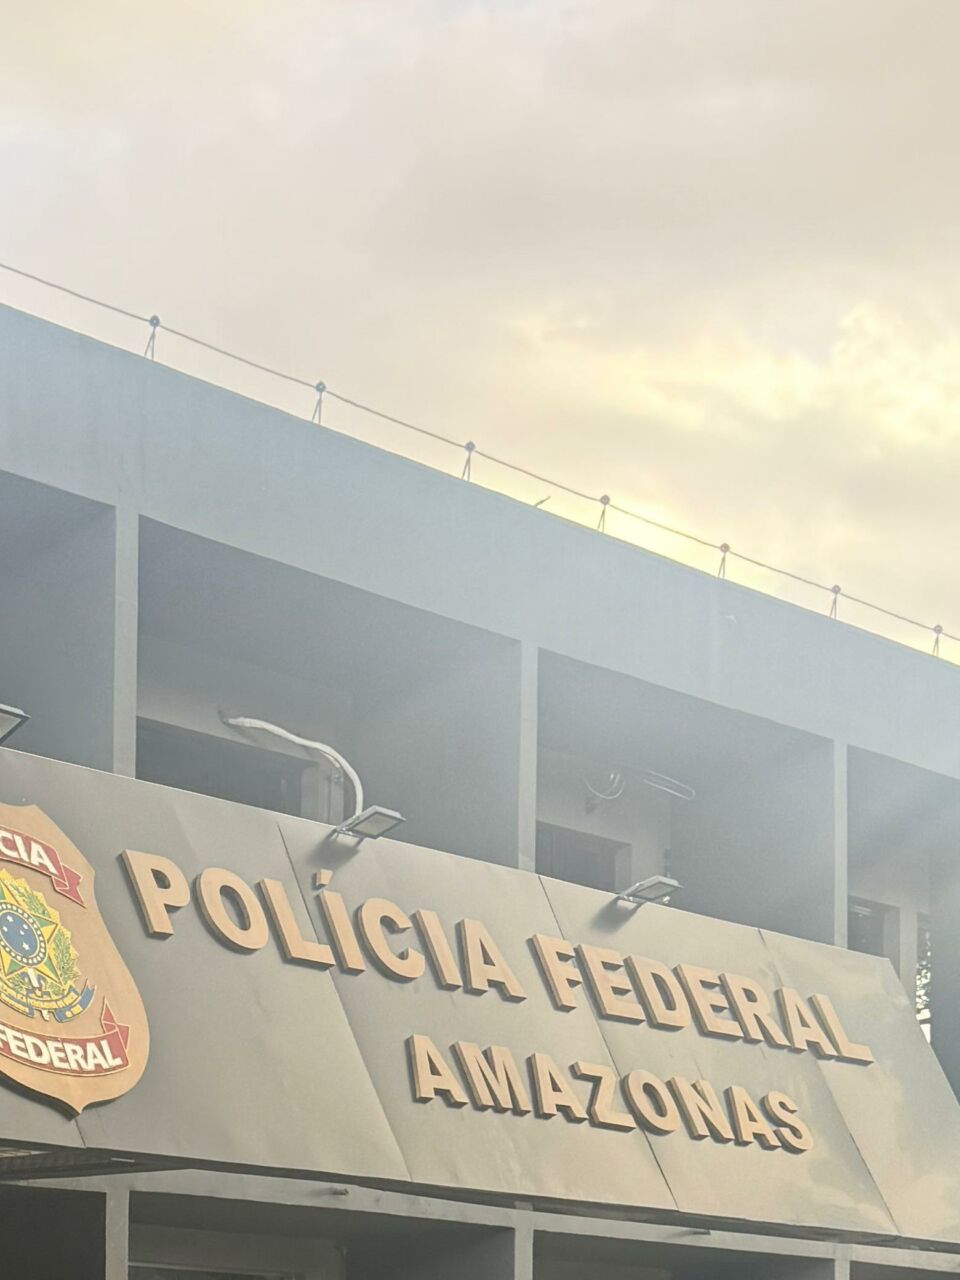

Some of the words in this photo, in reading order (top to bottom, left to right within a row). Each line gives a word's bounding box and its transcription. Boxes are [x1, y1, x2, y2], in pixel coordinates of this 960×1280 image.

[123, 849, 527, 1003] POLÍCIA
[530, 933, 875, 1066] FEDERAL
[407, 1034, 814, 1154] AMAZONAS
